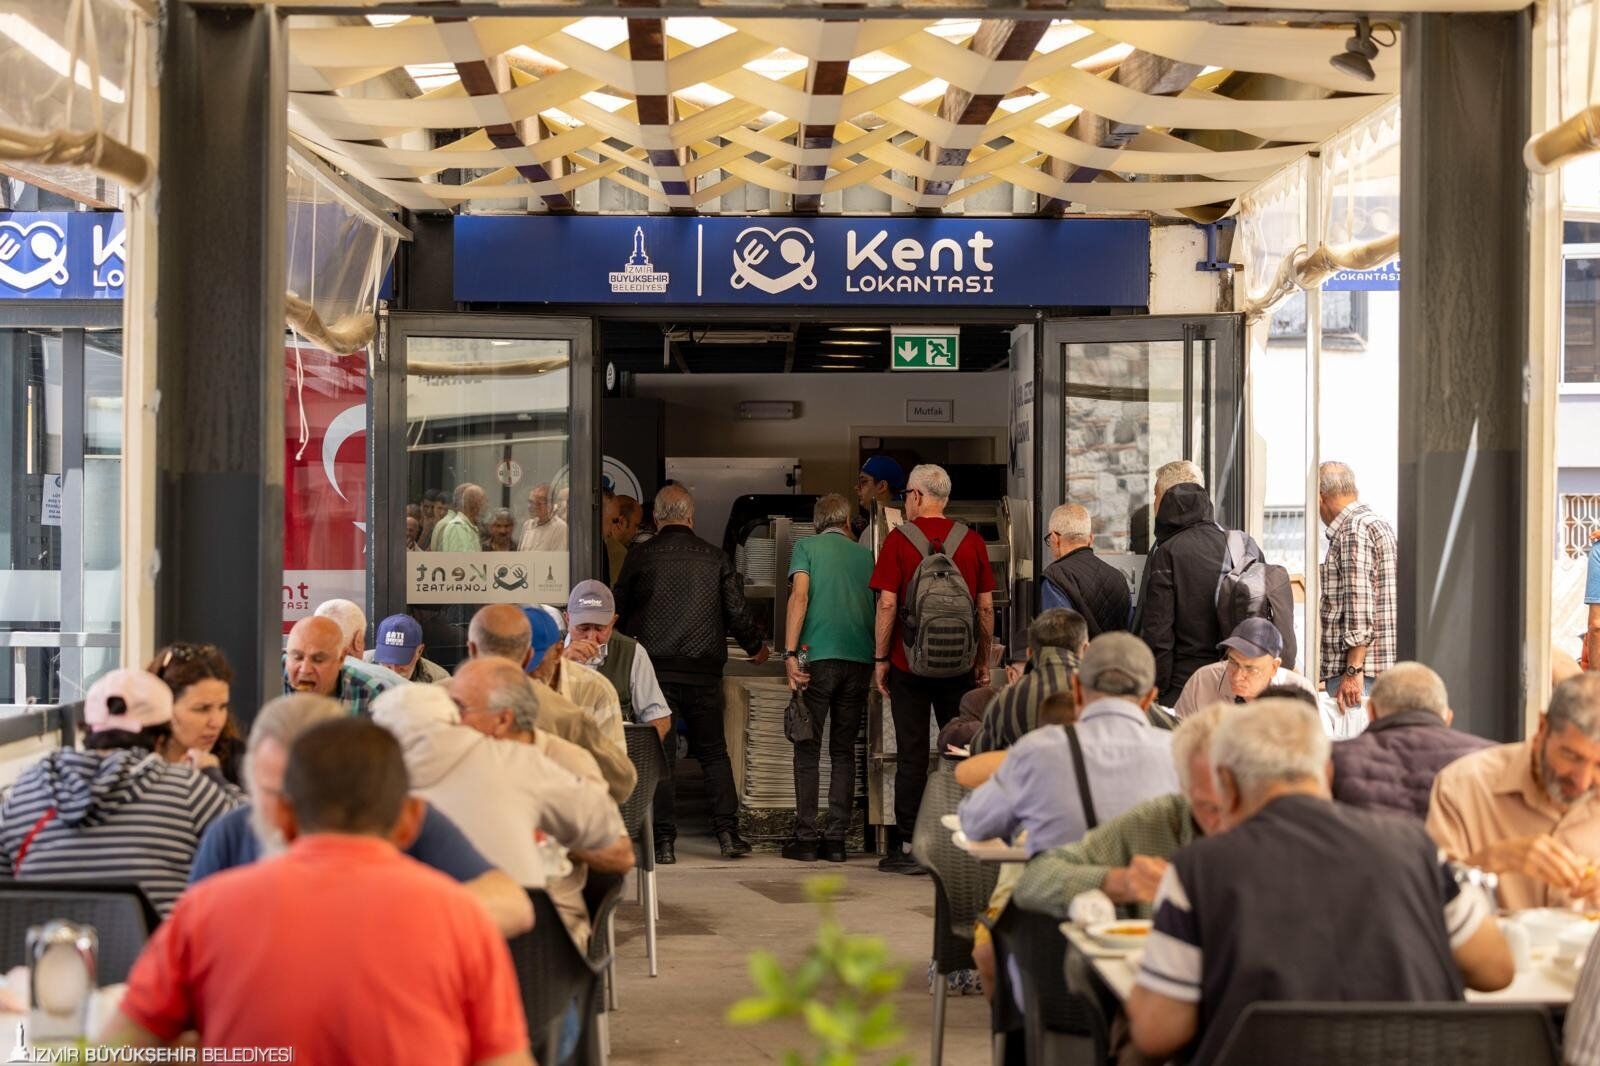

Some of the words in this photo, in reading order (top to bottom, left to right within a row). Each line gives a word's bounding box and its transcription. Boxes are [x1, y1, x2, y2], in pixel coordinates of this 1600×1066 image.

[93, 225, 126, 266] K
[847, 230, 994, 272] Kent
[93, 269, 125, 287] LO
[847, 275, 994, 293] LOKANTASI
[1333, 273, 1400, 281] LOKANTASI
[913, 407, 943, 416] Mutfak
[281, 582, 309, 600] nt
